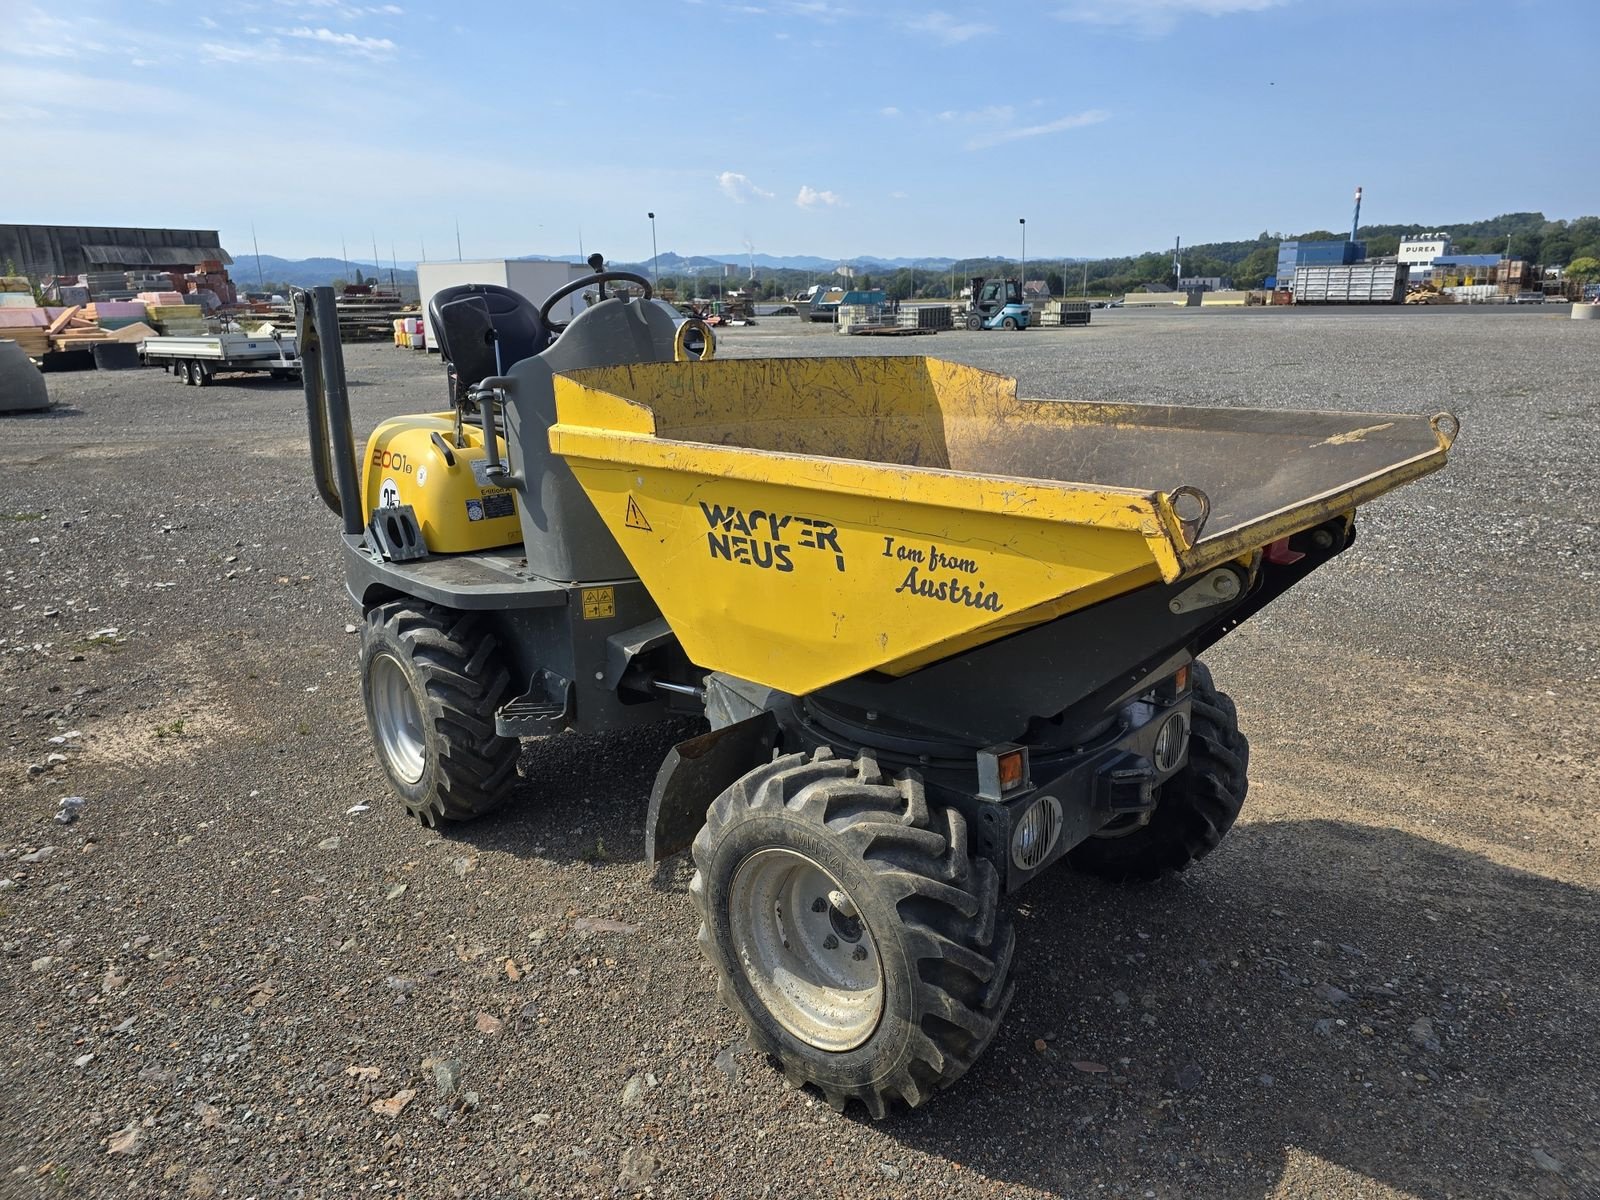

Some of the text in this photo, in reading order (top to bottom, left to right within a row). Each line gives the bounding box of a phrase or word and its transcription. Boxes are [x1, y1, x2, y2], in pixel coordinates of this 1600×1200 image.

[882, 536, 979, 573] I am from
[895, 566, 1004, 612] Austria
